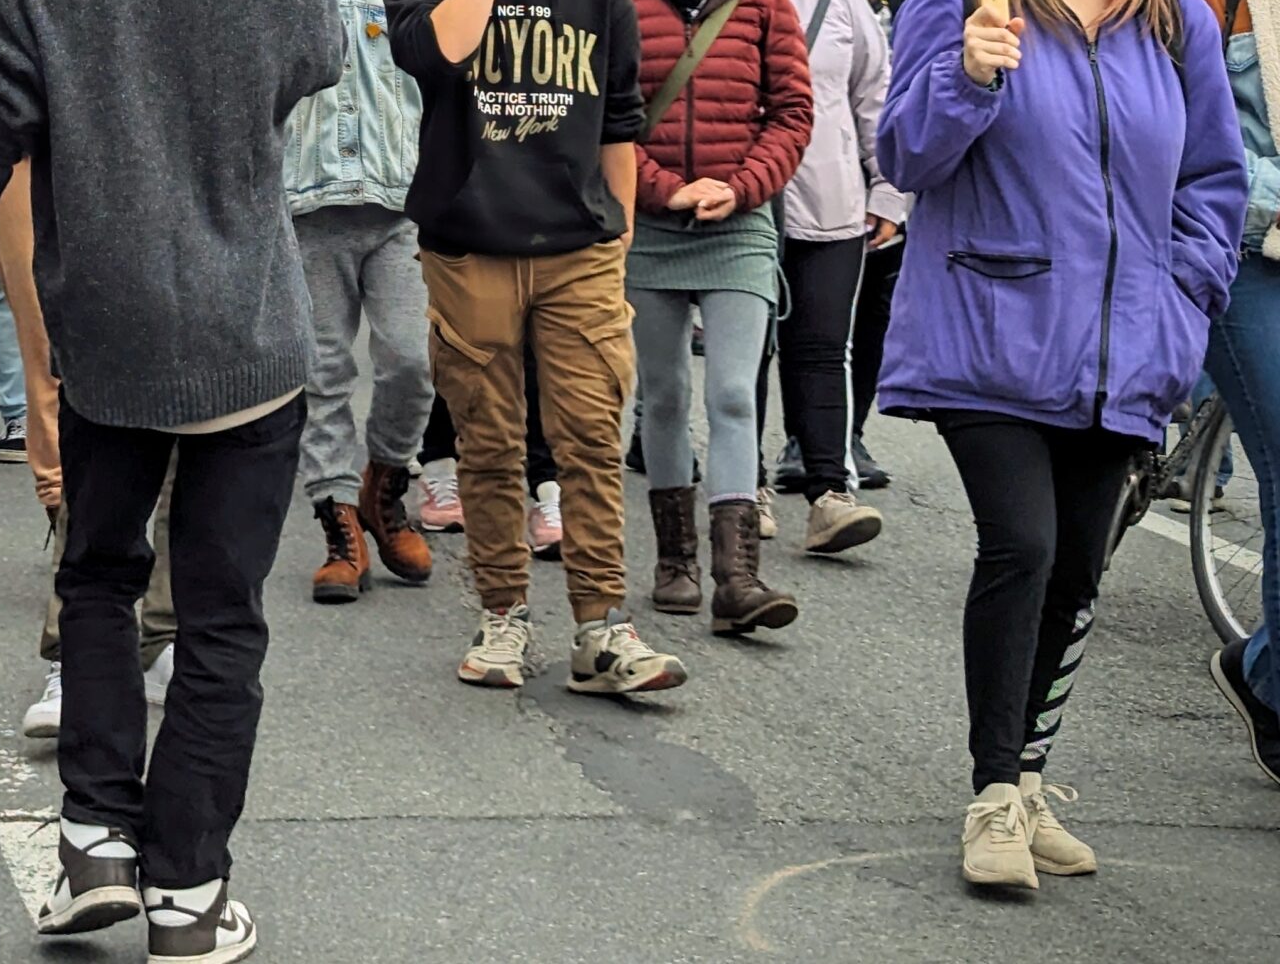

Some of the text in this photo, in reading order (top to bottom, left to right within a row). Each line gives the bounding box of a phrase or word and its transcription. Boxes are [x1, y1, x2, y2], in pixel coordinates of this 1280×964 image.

[497, 5, 552, 18] NCE 199
[508, 18, 600, 97] YORK
[473, 86, 574, 105] ACTICE TRUTH
[505, 103, 568, 116] NOTHING
[514, 115, 559, 143] York
